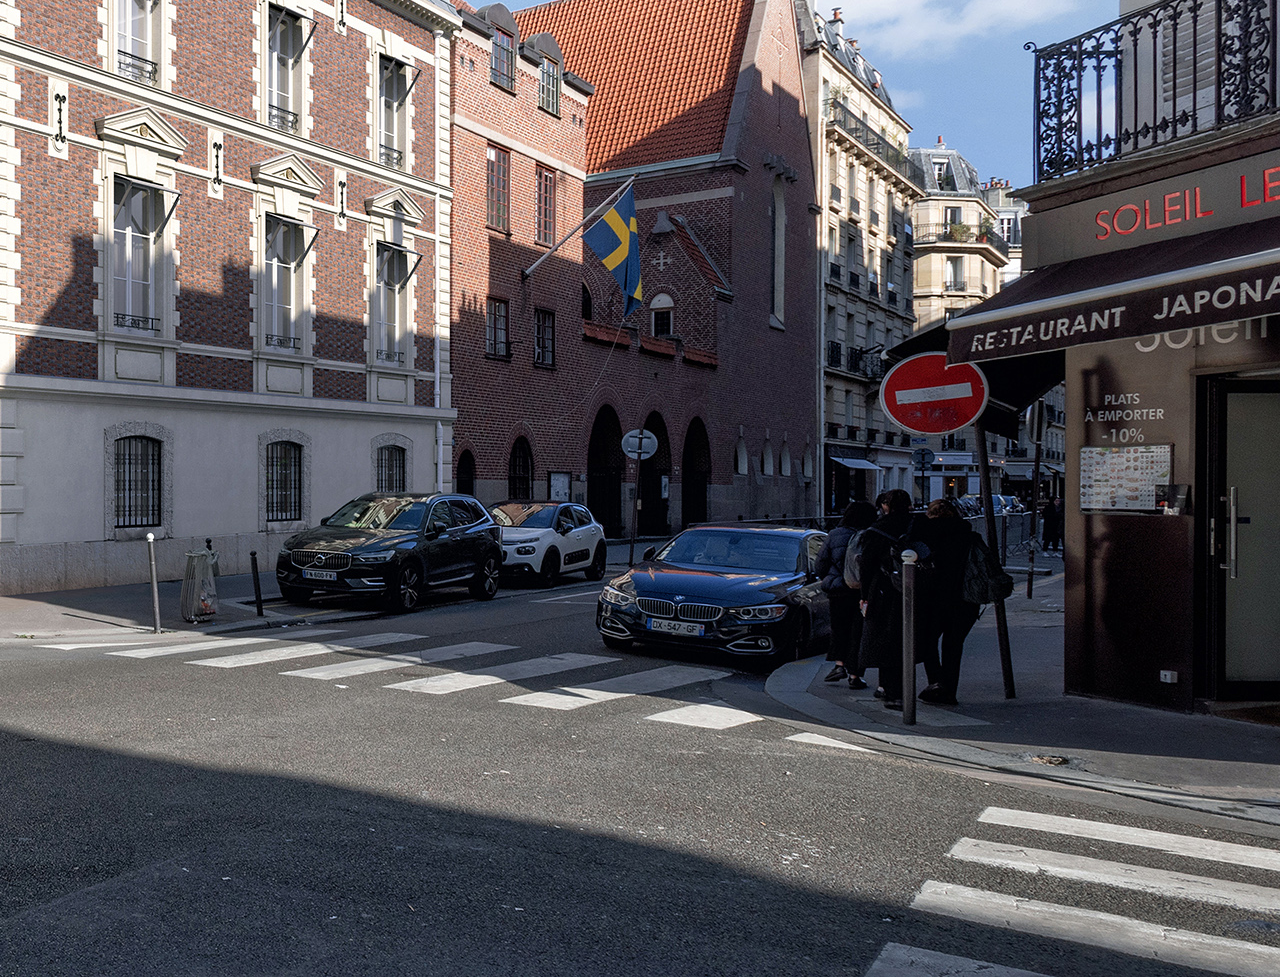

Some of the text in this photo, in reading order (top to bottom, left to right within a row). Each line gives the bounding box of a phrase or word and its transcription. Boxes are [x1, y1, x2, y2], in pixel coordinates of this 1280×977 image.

[1095, 186, 1214, 241] SOLEIL
[1104, 392, 1141, 406] PLATS
[1084, 407, 1165, 422] À EMPORTER
[1101, 427, 1145, 443] -10%
